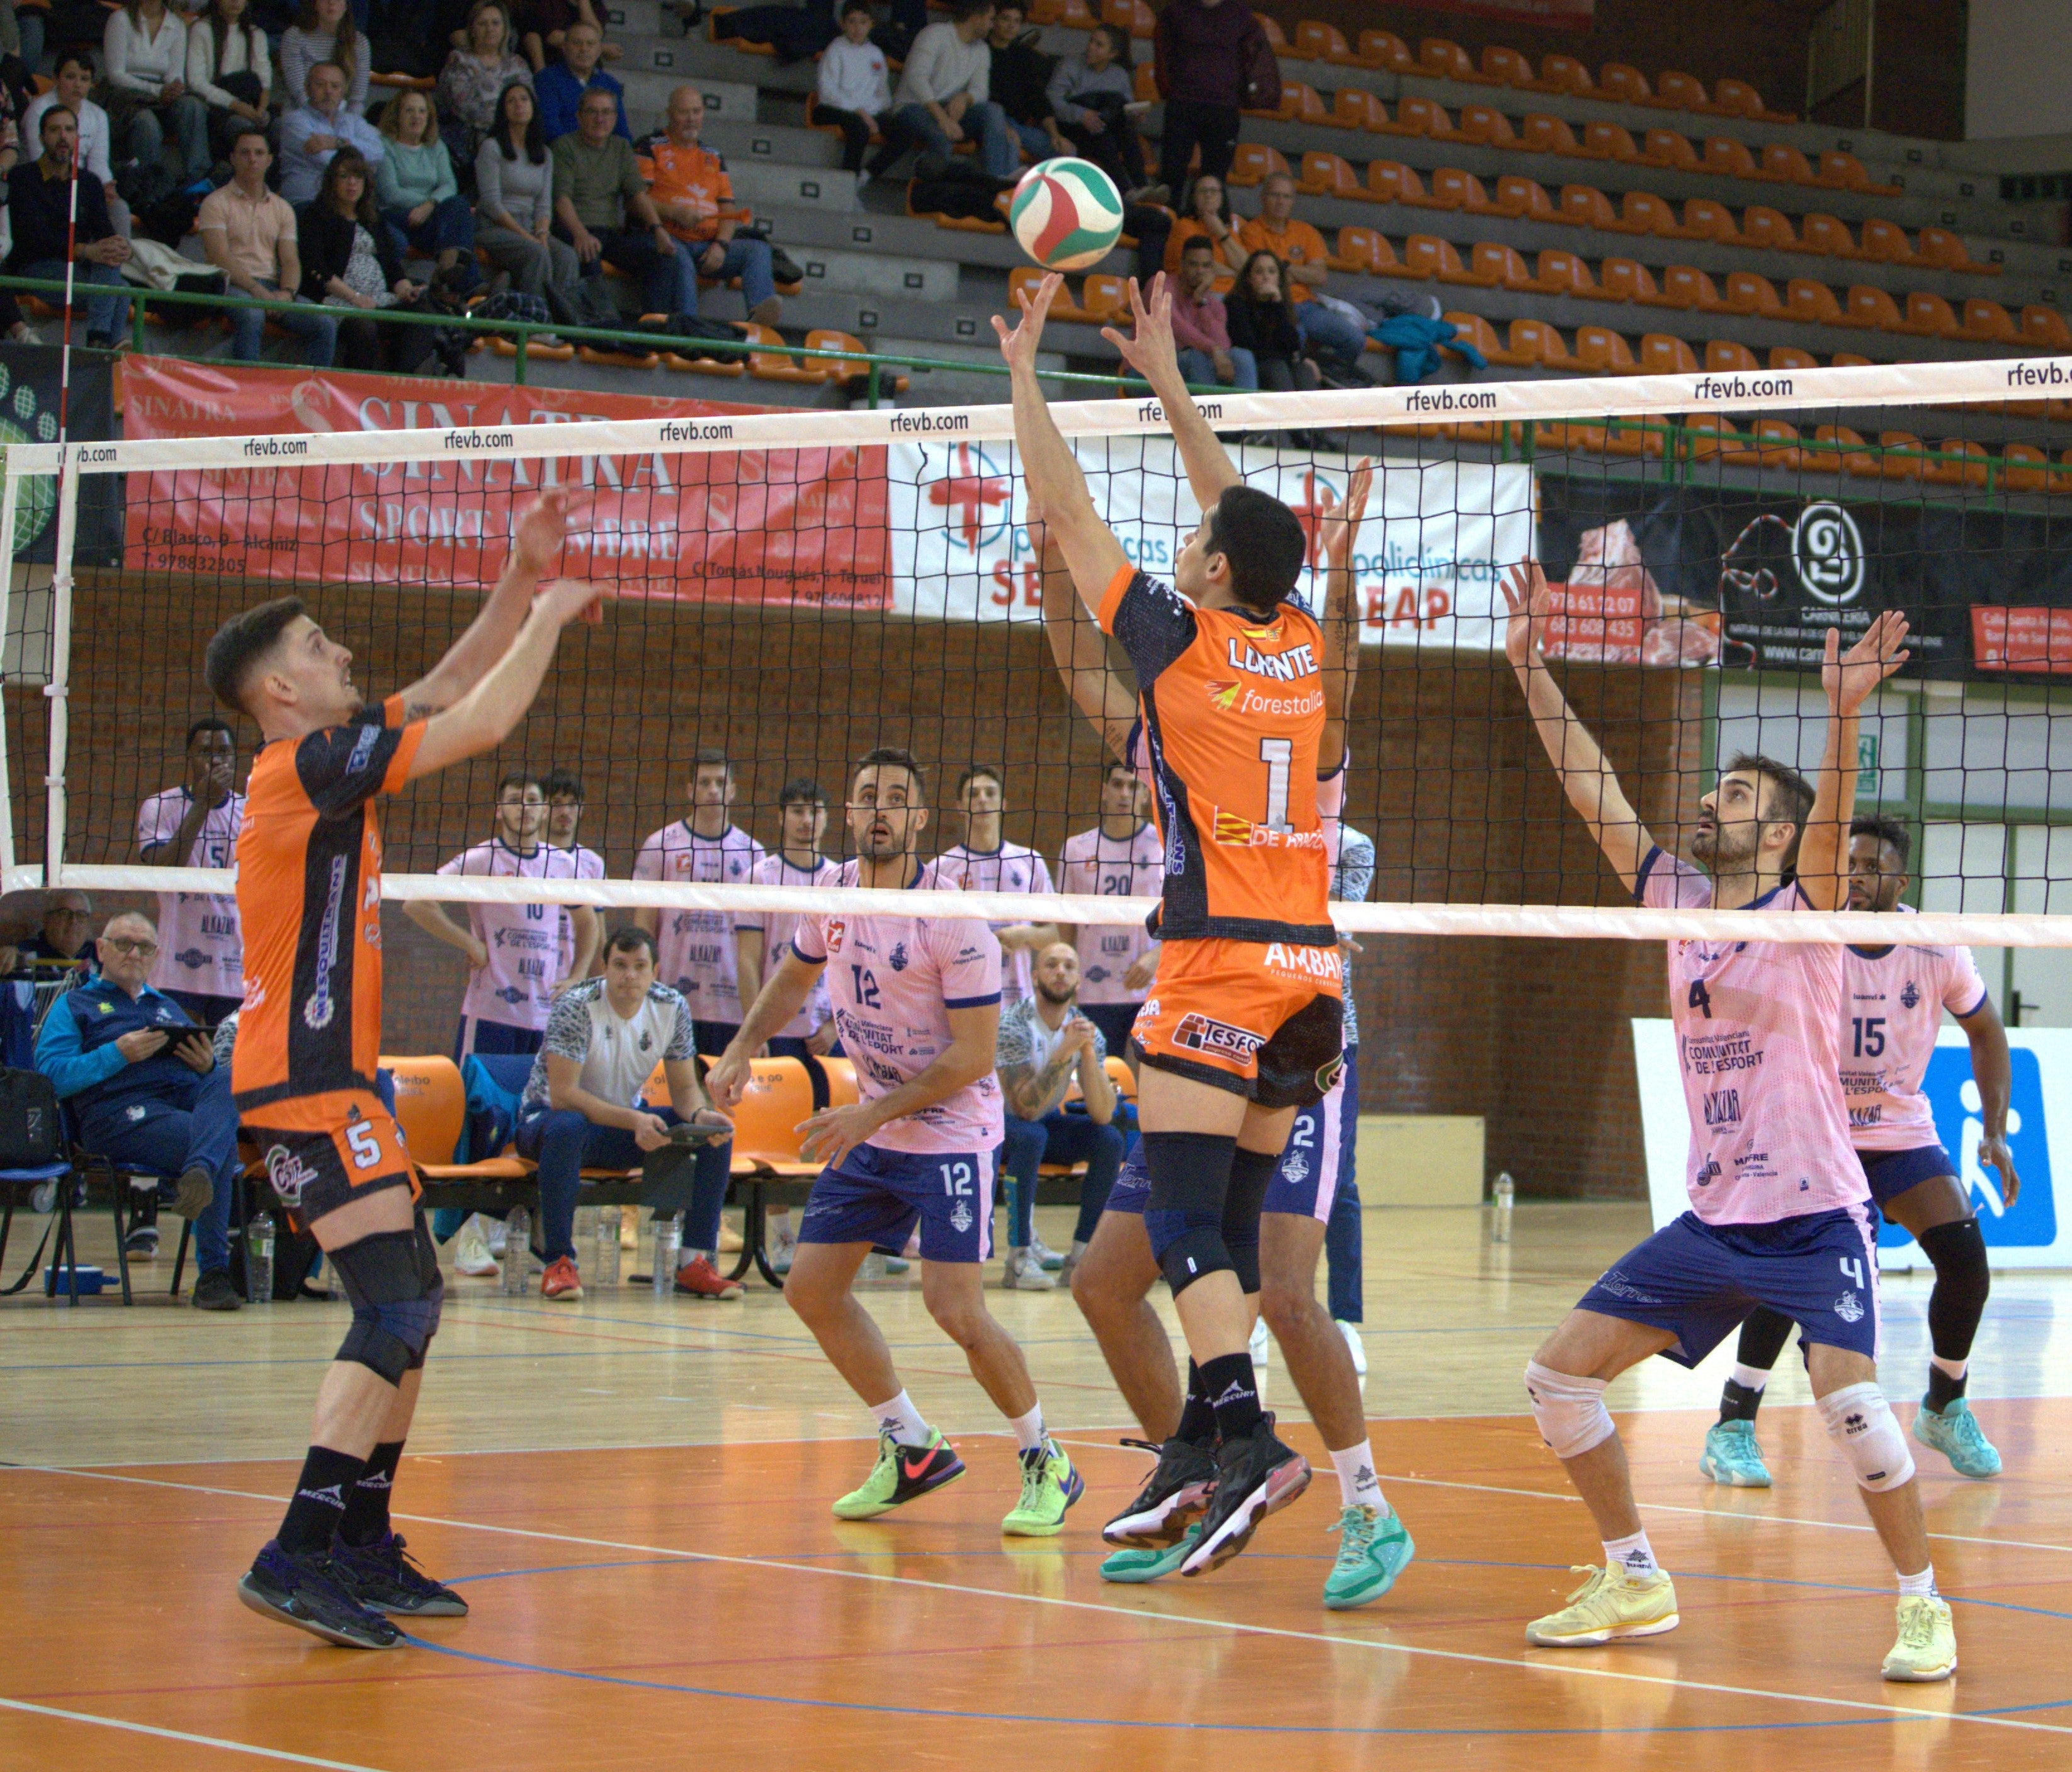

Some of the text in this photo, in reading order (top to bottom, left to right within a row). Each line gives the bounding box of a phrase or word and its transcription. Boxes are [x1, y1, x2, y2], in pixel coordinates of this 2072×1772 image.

[2008, 361, 2072, 386] rfevb.
[1695, 376, 1793, 400] rfevb.com
[1406, 390, 1497, 412] rfevb.com
[660, 421, 733, 442] rfevb.com
[890, 410, 969, 432] rfevb.com
[244, 437, 308, 456] rfevb.com
[358, 396, 679, 495] SINATRA
[444, 430, 513, 449] rfevb.com
[359, 501, 493, 551] SPORT
[244, 535, 298, 552] Alcañiz
[1352, 540, 1503, 585] policlínicas
[841, 571, 883, 584] Teruel
[1358, 585, 1451, 630] EAP
[1550, 591, 1575, 609] 978
[1578, 595, 1595, 612] 61
[1617, 597, 1636, 613] 07
[1608, 620, 1635, 638] 435
[1240, 689, 1323, 715] forestalia
[1260, 737, 1294, 834] 1
[1253, 829, 1323, 850] DE ARAGÓ
[1104, 874, 1129, 895] 20
[851, 964, 881, 1010] 12
[1688, 978, 1713, 1019] 4
[1689, 1039, 1752, 1060] COMUNITAT
[1852, 1017, 1886, 1058] 15
[1695, 1061, 1711, 1075] DE
[346, 1119, 382, 1170] 5
[939, 1162, 973, 1196] 12
[1839, 1256, 1865, 1290] 4
